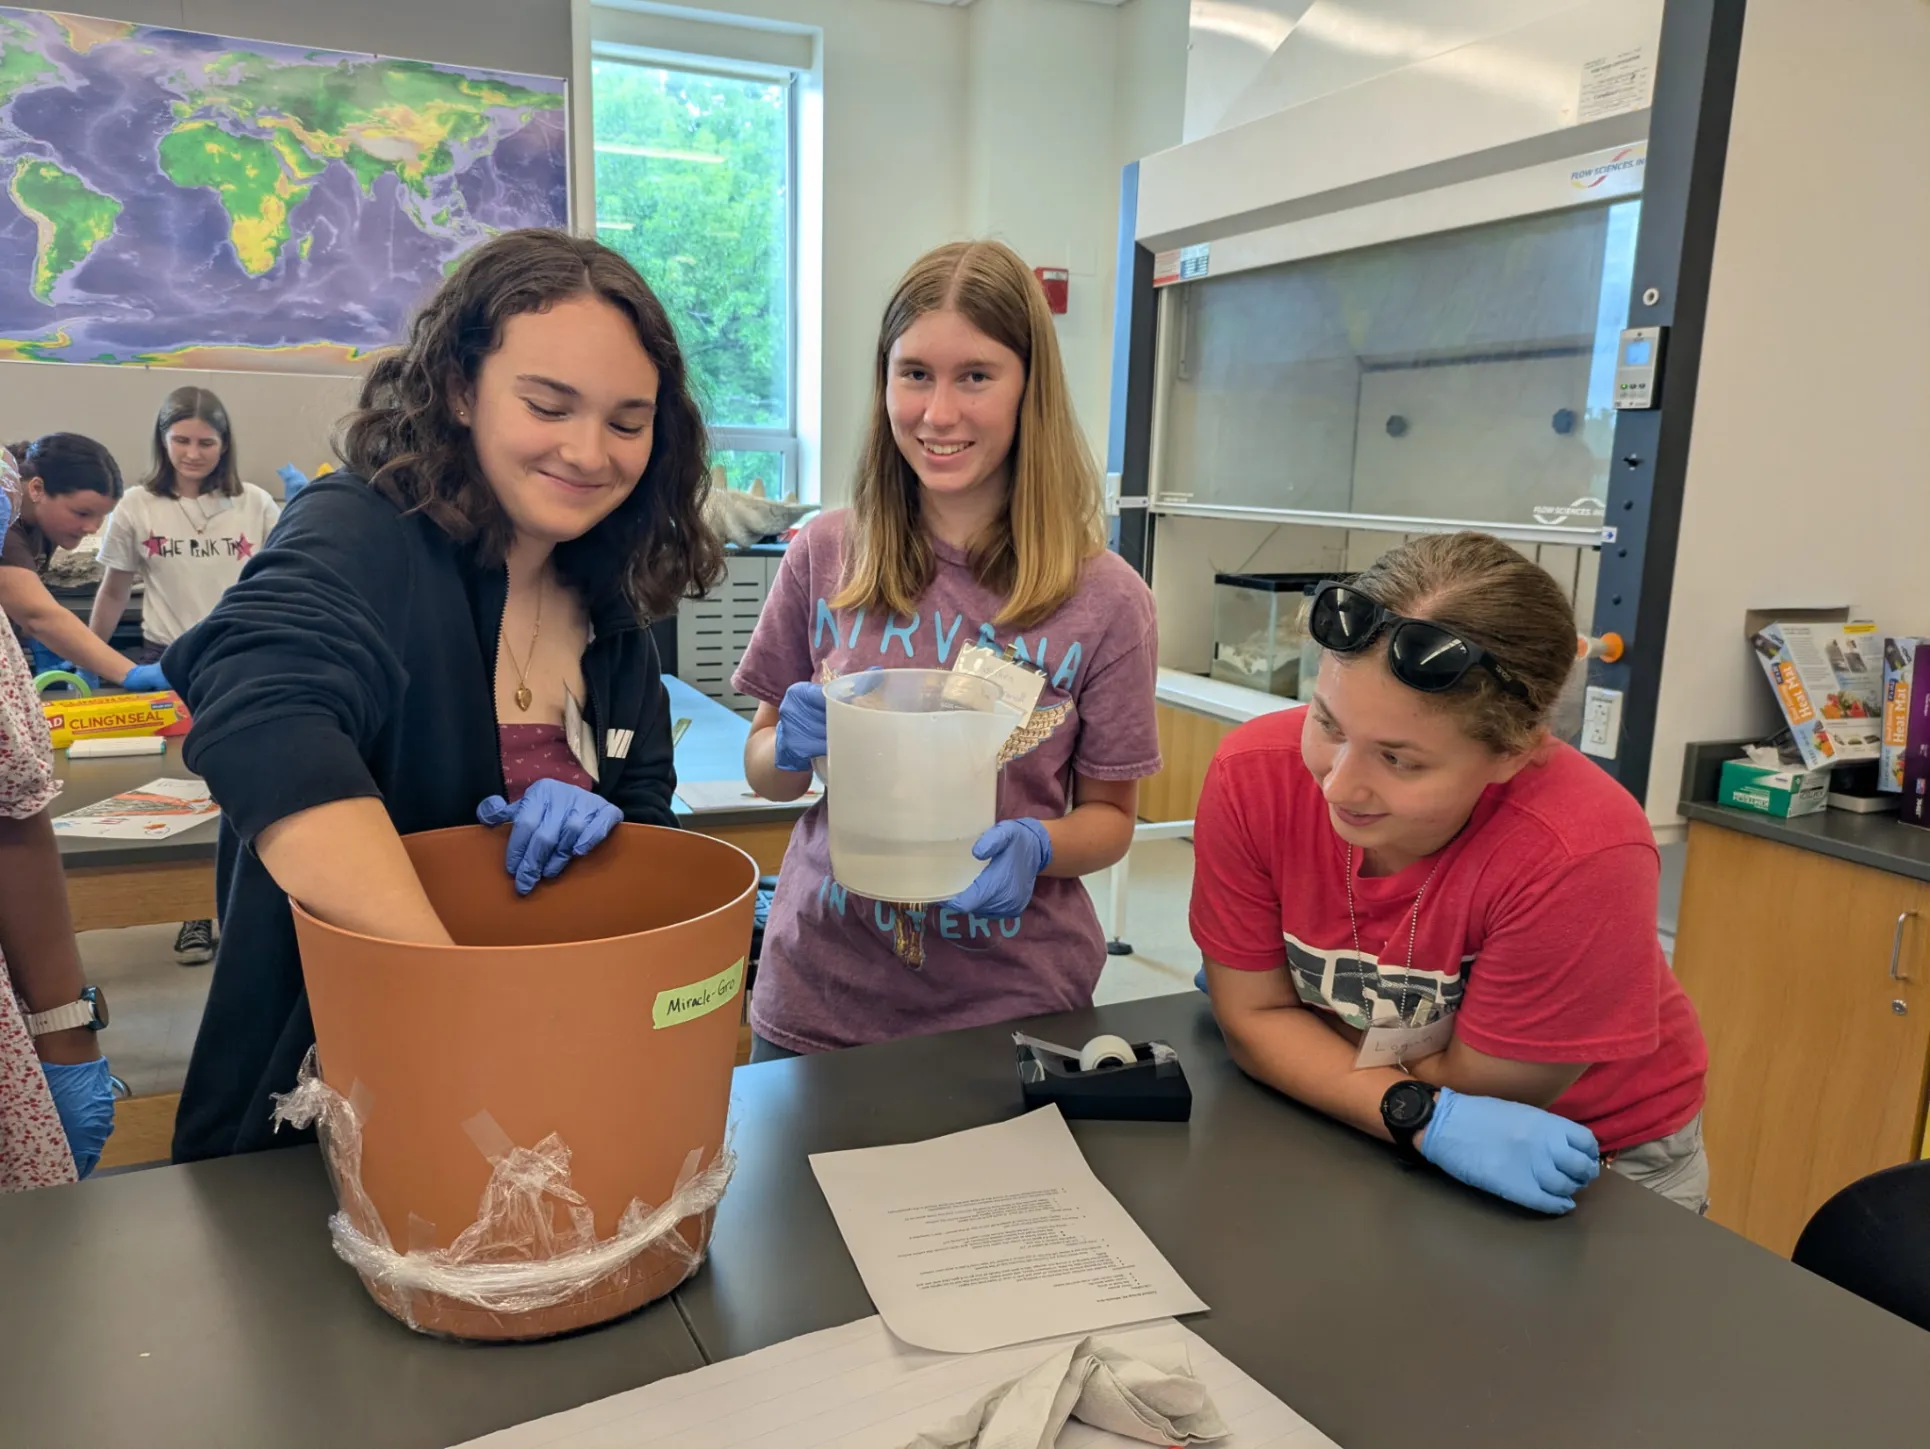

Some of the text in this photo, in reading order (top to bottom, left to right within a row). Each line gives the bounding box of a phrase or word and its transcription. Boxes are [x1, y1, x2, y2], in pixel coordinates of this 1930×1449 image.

[1571, 168, 1593, 181] FLOW
[151, 535, 184, 557] THE
[813, 598, 1082, 690] NIRVANA
[48, 717, 63, 729] AD
[128, 711, 164, 722] SEAL
[1893, 688, 1907, 743] Heat Mat
[819, 875, 848, 916] IN
[666, 979, 735, 1016] Miracle-Gro
